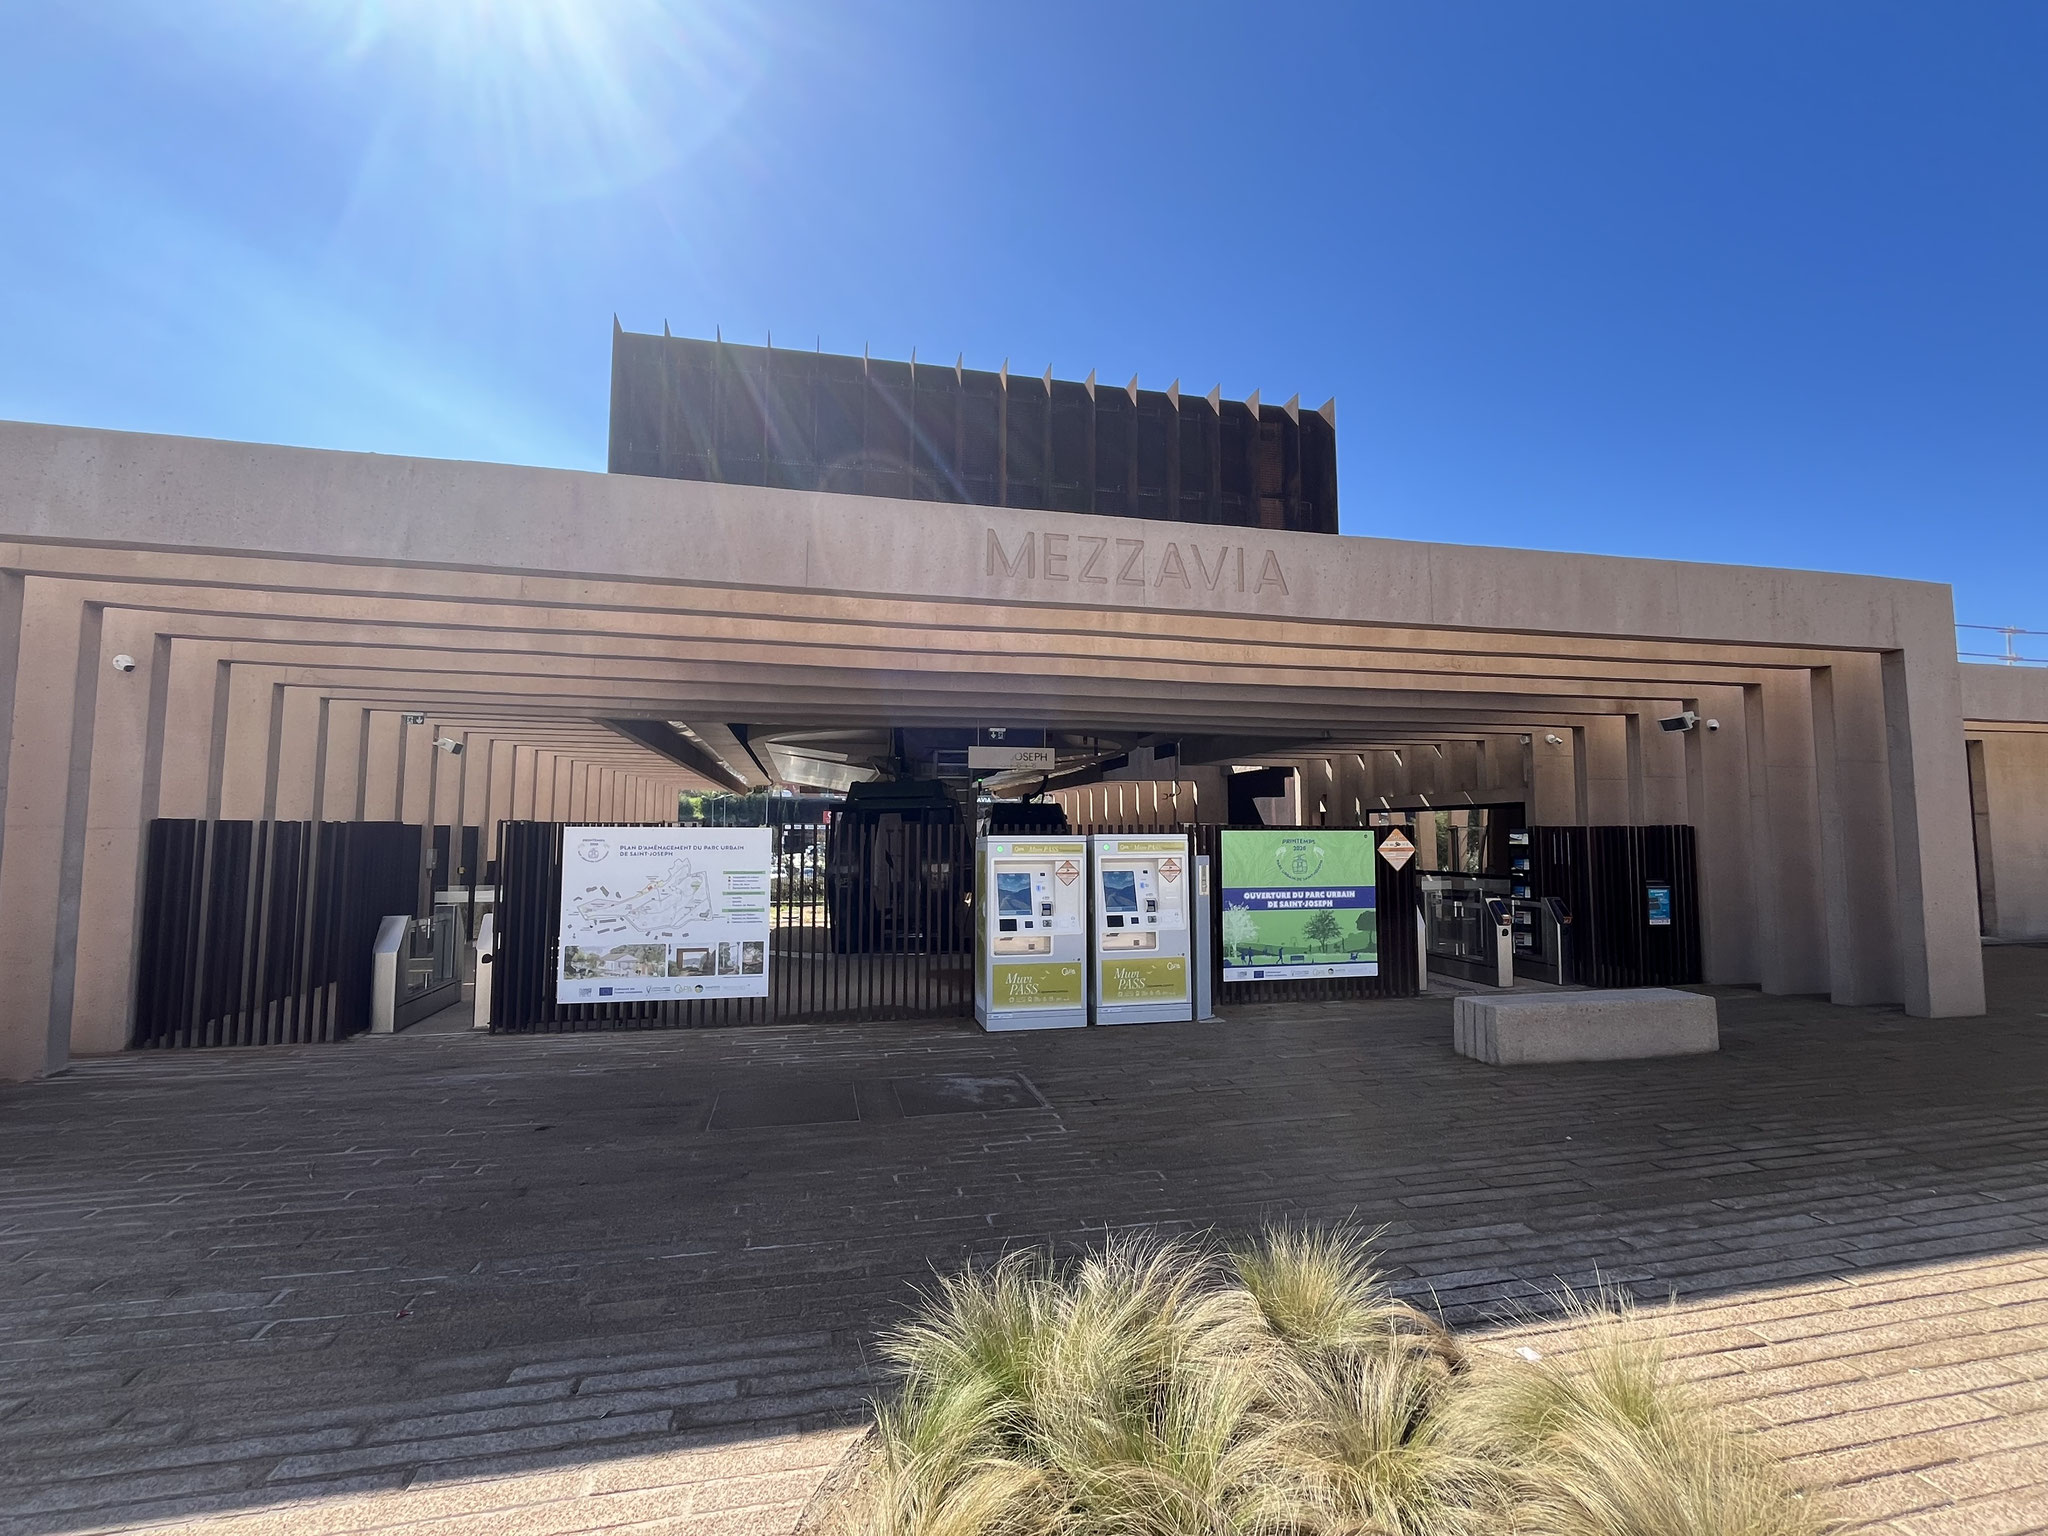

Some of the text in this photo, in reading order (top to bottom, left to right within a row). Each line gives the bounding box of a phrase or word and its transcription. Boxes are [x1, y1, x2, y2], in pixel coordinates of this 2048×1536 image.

[986, 527, 1290, 596] MEZZAVIA
[1243, 890, 1356, 900] OUVERTURE DU PARC URBAIN
[1267, 899, 1334, 909] DE SAINT-JOSEPH
[1009, 983, 1040, 996] PASS
[1118, 977, 1146, 990] PASS
